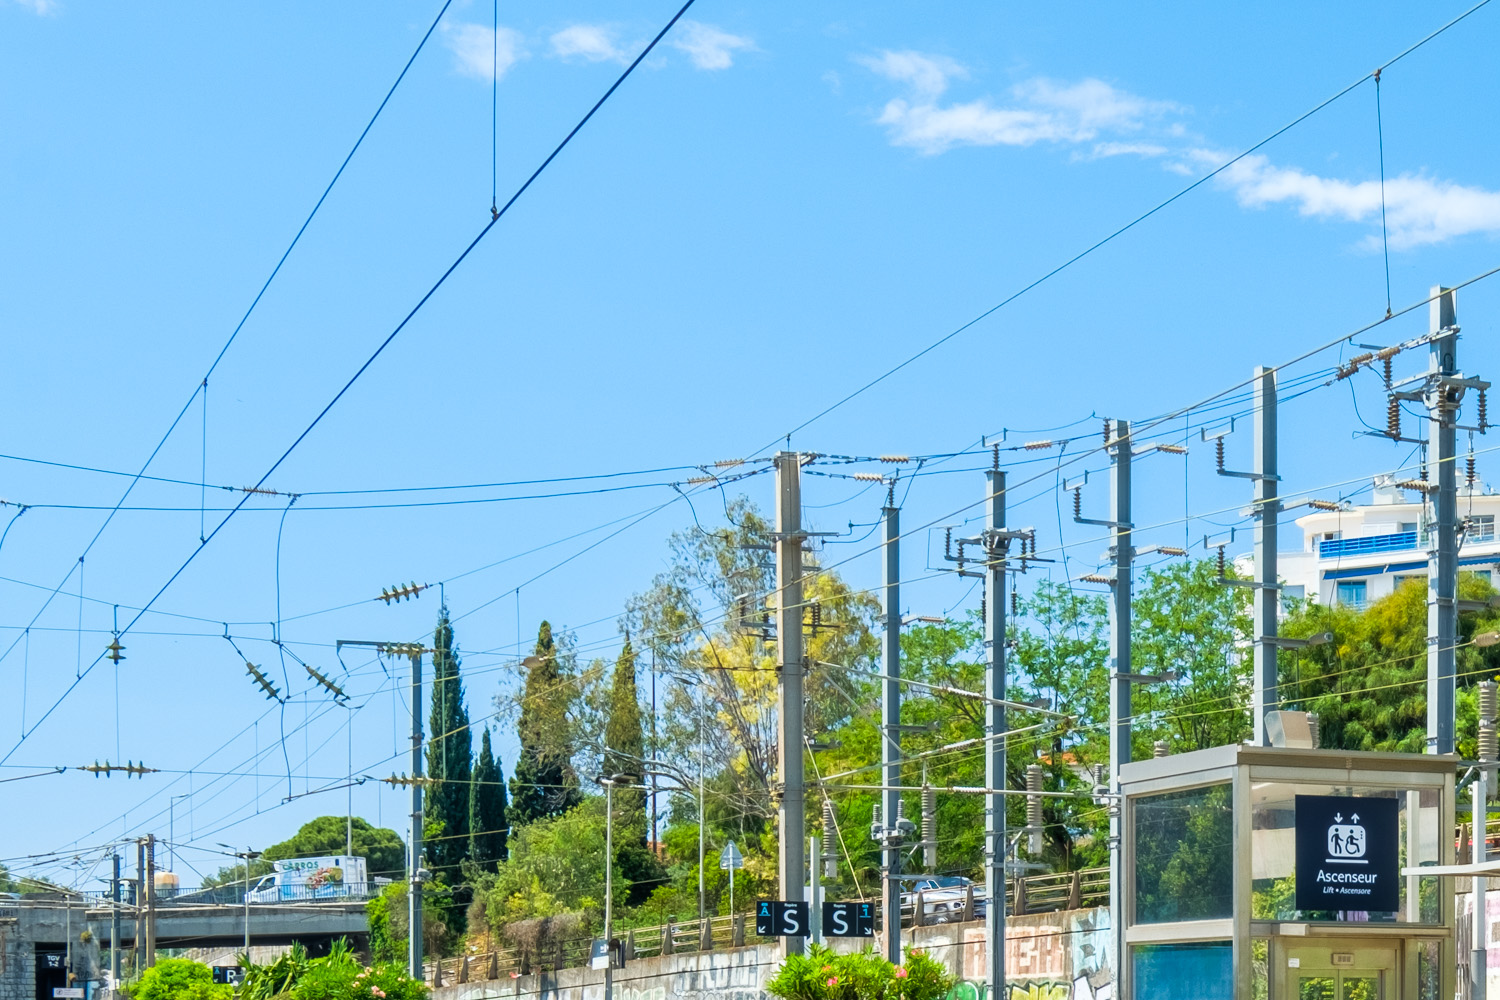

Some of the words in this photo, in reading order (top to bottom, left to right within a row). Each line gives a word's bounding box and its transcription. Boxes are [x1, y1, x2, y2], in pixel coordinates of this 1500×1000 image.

[1316, 869, 1378, 884] Ascenseur
[1323, 886, 1335, 894] Lift
[1339, 886, 1372, 895] Ascensore
[761, 906, 769, 914] A
[783, 909, 800, 935] S
[832, 909, 849, 935] S
